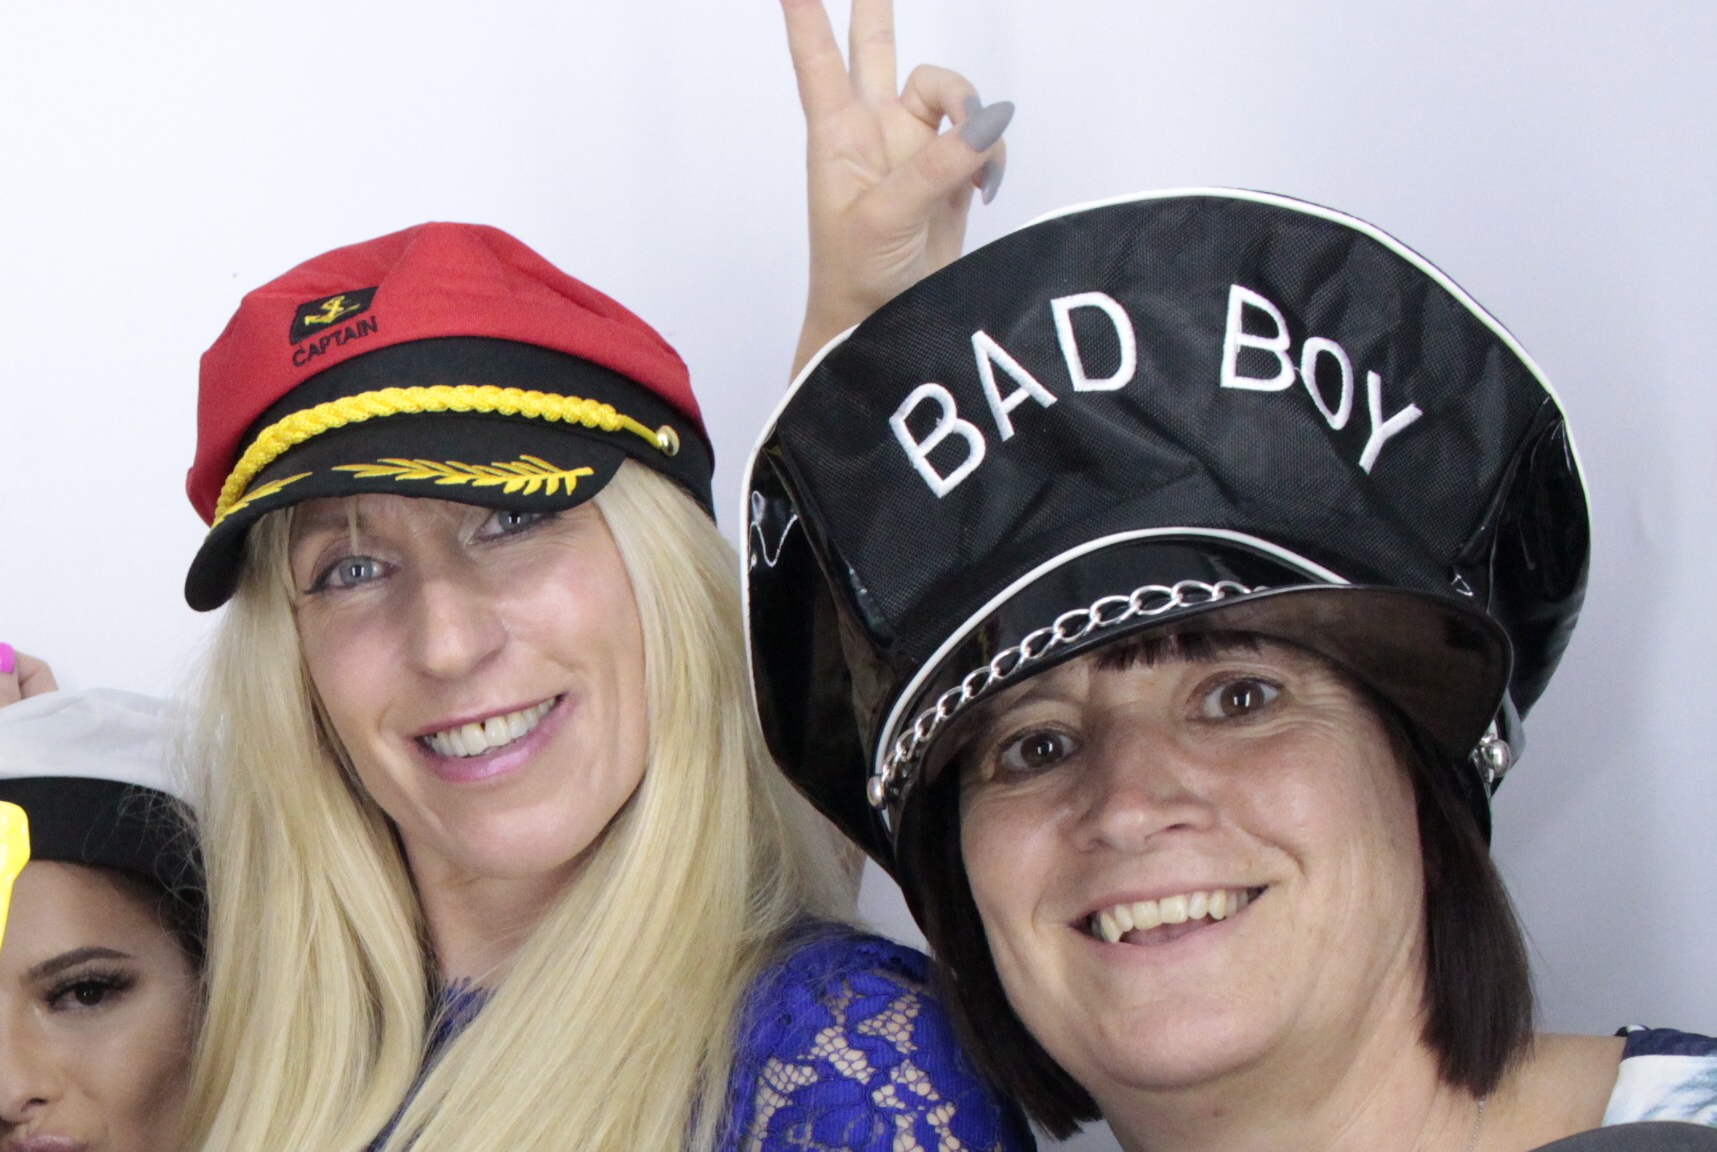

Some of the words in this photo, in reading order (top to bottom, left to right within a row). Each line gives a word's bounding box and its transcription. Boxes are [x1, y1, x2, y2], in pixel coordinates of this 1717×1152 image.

[293, 315, 378, 367] CAPTAIN
[888, 291, 1137, 499] BAD
[1219, 284, 1423, 475] BOY
